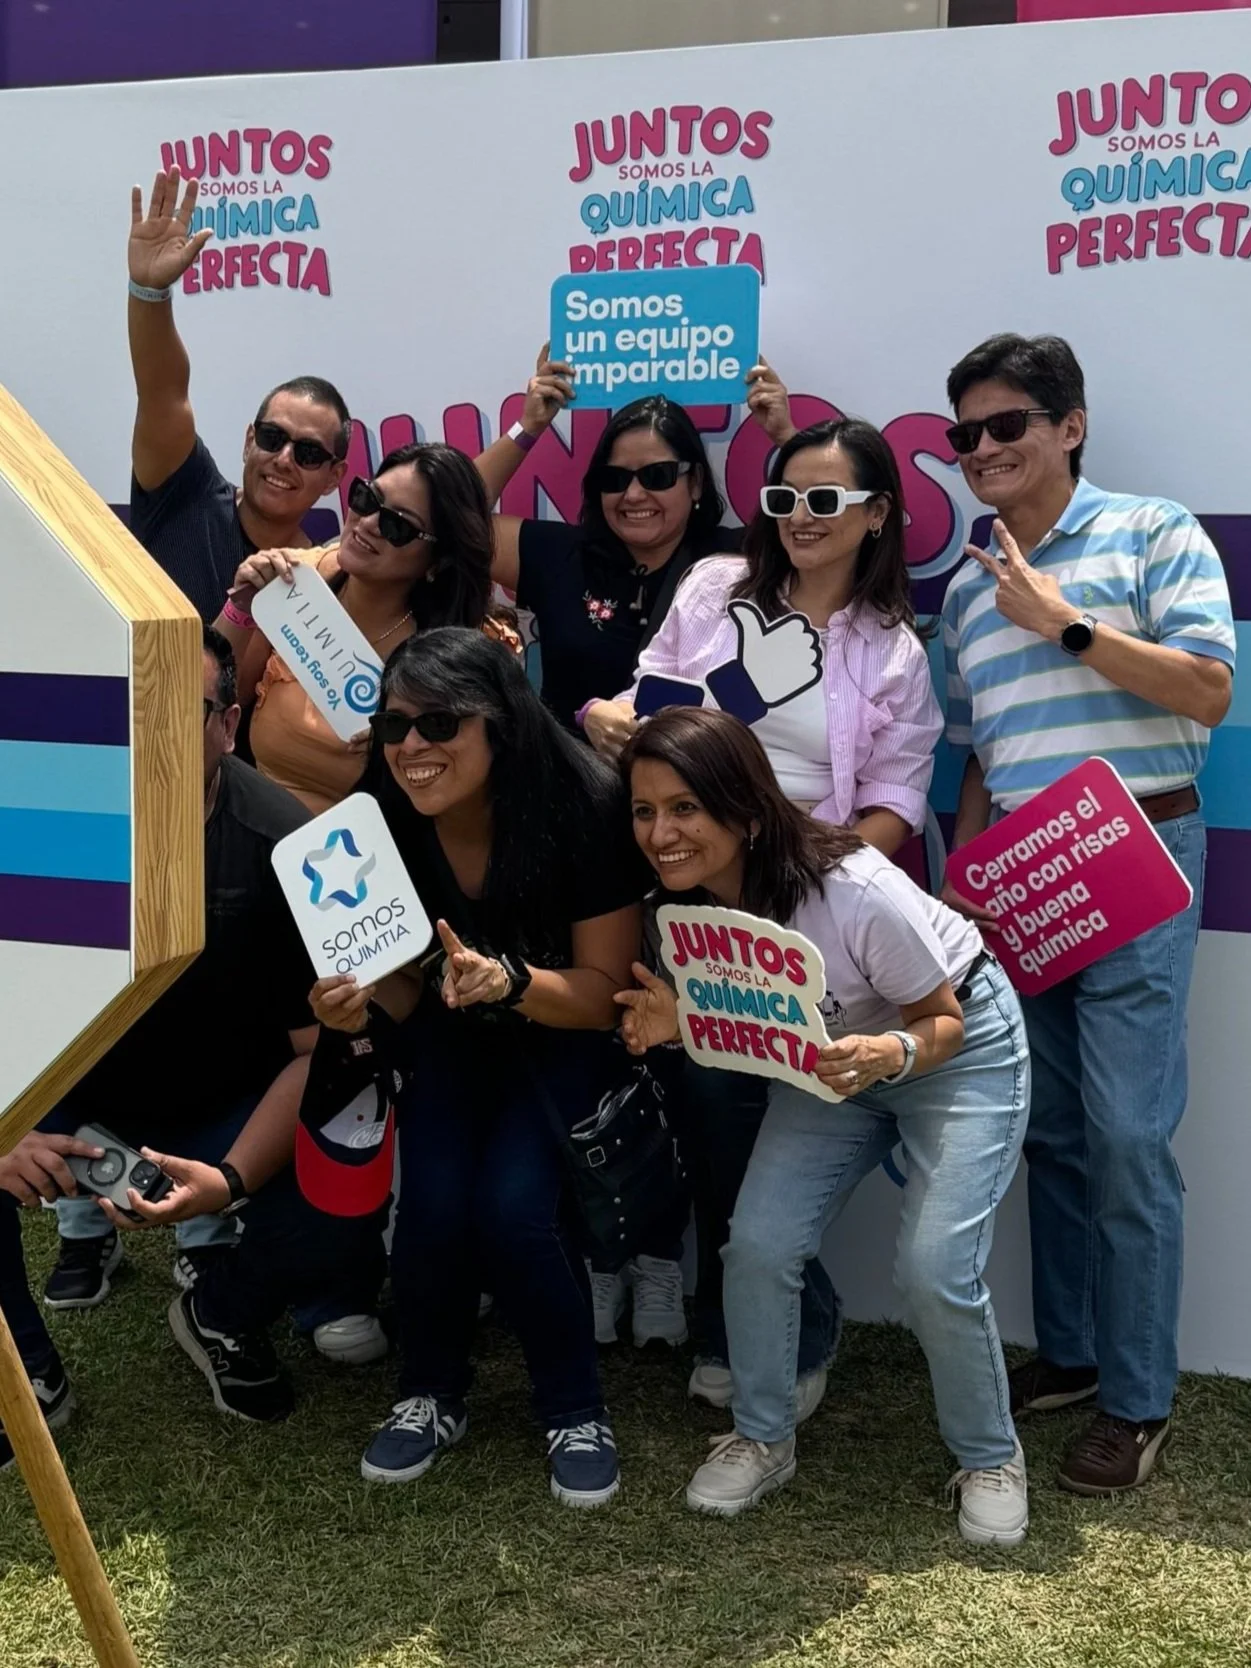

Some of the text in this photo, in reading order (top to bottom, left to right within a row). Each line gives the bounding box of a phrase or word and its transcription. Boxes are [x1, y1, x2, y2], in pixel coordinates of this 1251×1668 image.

[1048, 72, 1251, 156] JUNTO
[1107, 131, 1220, 152] SOMOS LA
[568, 105, 773, 182] JUNTOS
[618, 161, 714, 180] SOMOS LA
[200, 180, 284, 196] SOMOS LA
[580, 175, 755, 235] QUÍMICA
[187, 194, 319, 240] UÍMICA
[183, 241, 331, 296] ERFECTA
[566, 290, 683, 322] Somos
[566, 317, 734, 358] un equipo
[280, 624, 341, 711] Yo soy team
[965, 786, 1102, 890] Cerramos el
[984, 815, 1131, 918] año con risas
[1001, 880, 1091, 953] y buena
[1018, 909, 1109, 977] química
[336, 923, 411, 975] QUIMTIA
[668, 921, 808, 987] JUNTOS
[705, 962, 772, 989] SOMOS LA
[686, 977, 808, 1027] QUÍMICA
